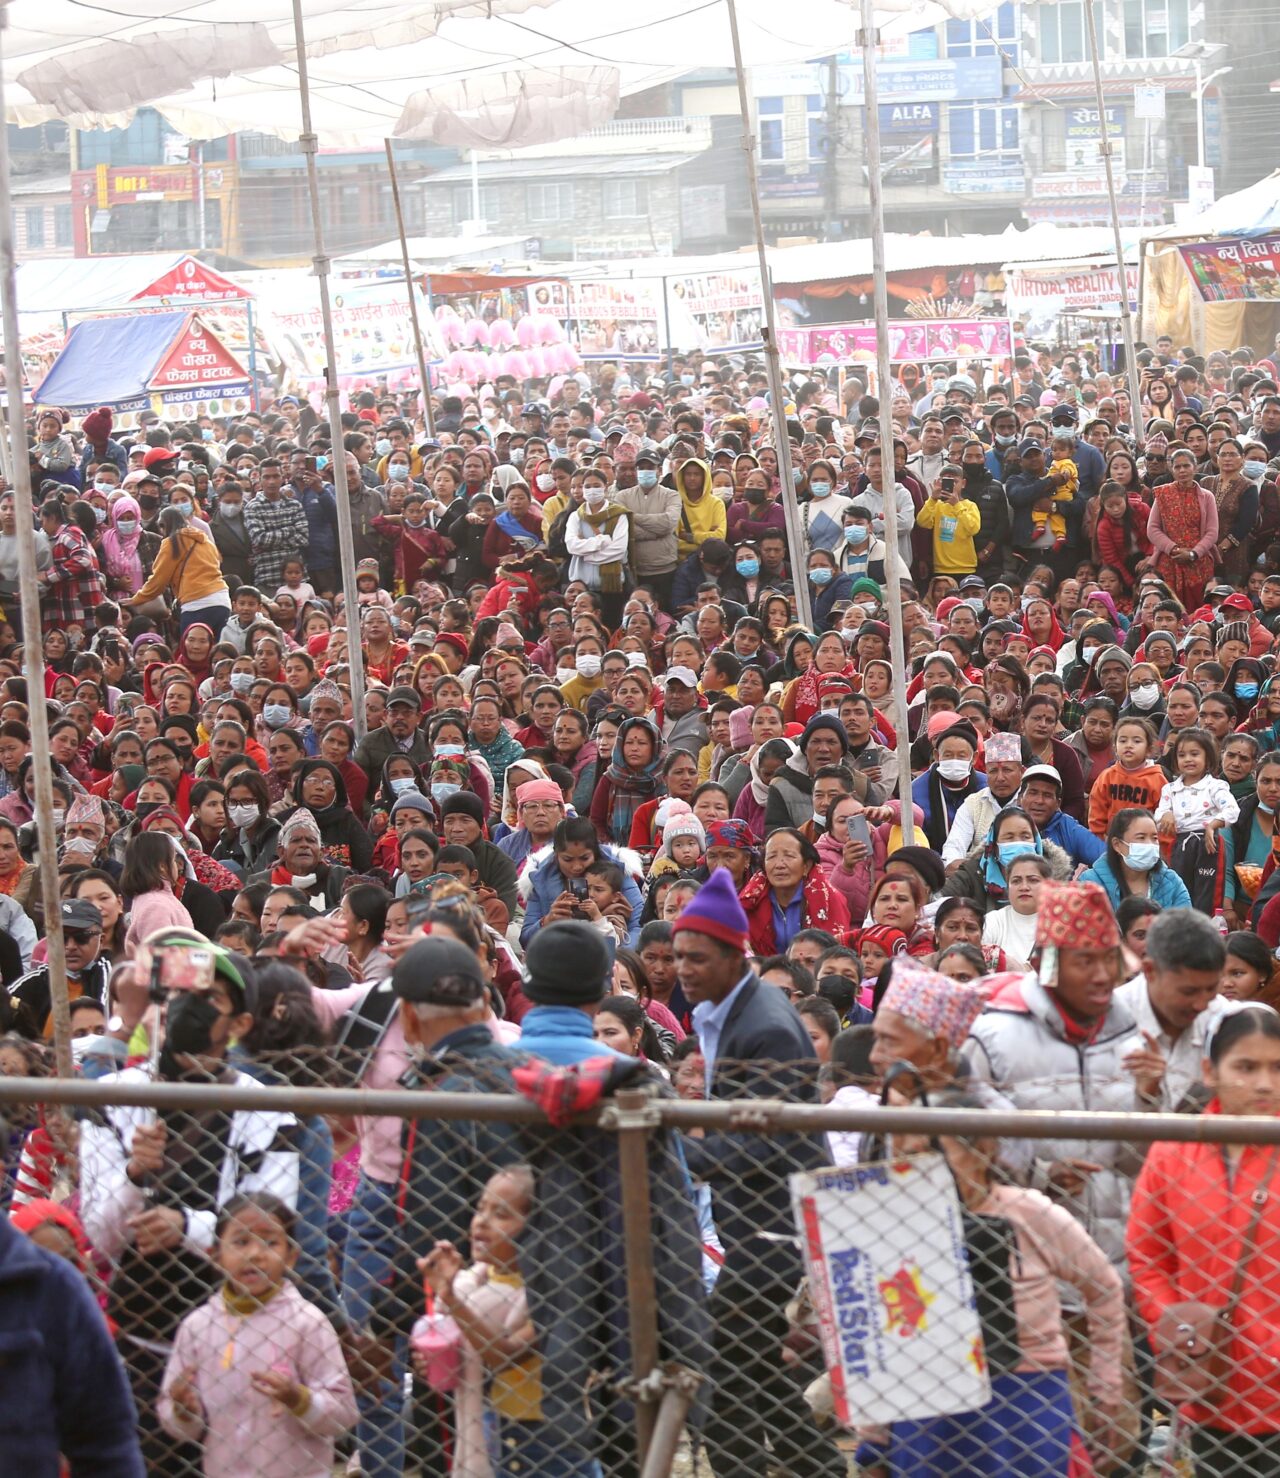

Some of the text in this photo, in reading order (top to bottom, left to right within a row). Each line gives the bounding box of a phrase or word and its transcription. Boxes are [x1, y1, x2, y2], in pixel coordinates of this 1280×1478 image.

[892, 105, 932, 121] ALFA
[1011, 278, 1065, 296] VIRTUAL
[1065, 271, 1115, 294] REALITY
[309, 306, 345, 325] फेस
[641, 306, 657, 318] TEA
[182, 352, 217, 367] पोखरा
[166, 367, 199, 382] फेमस
[165, 391, 193, 402] पोखरा
[1109, 783, 1149, 804] MERCI
